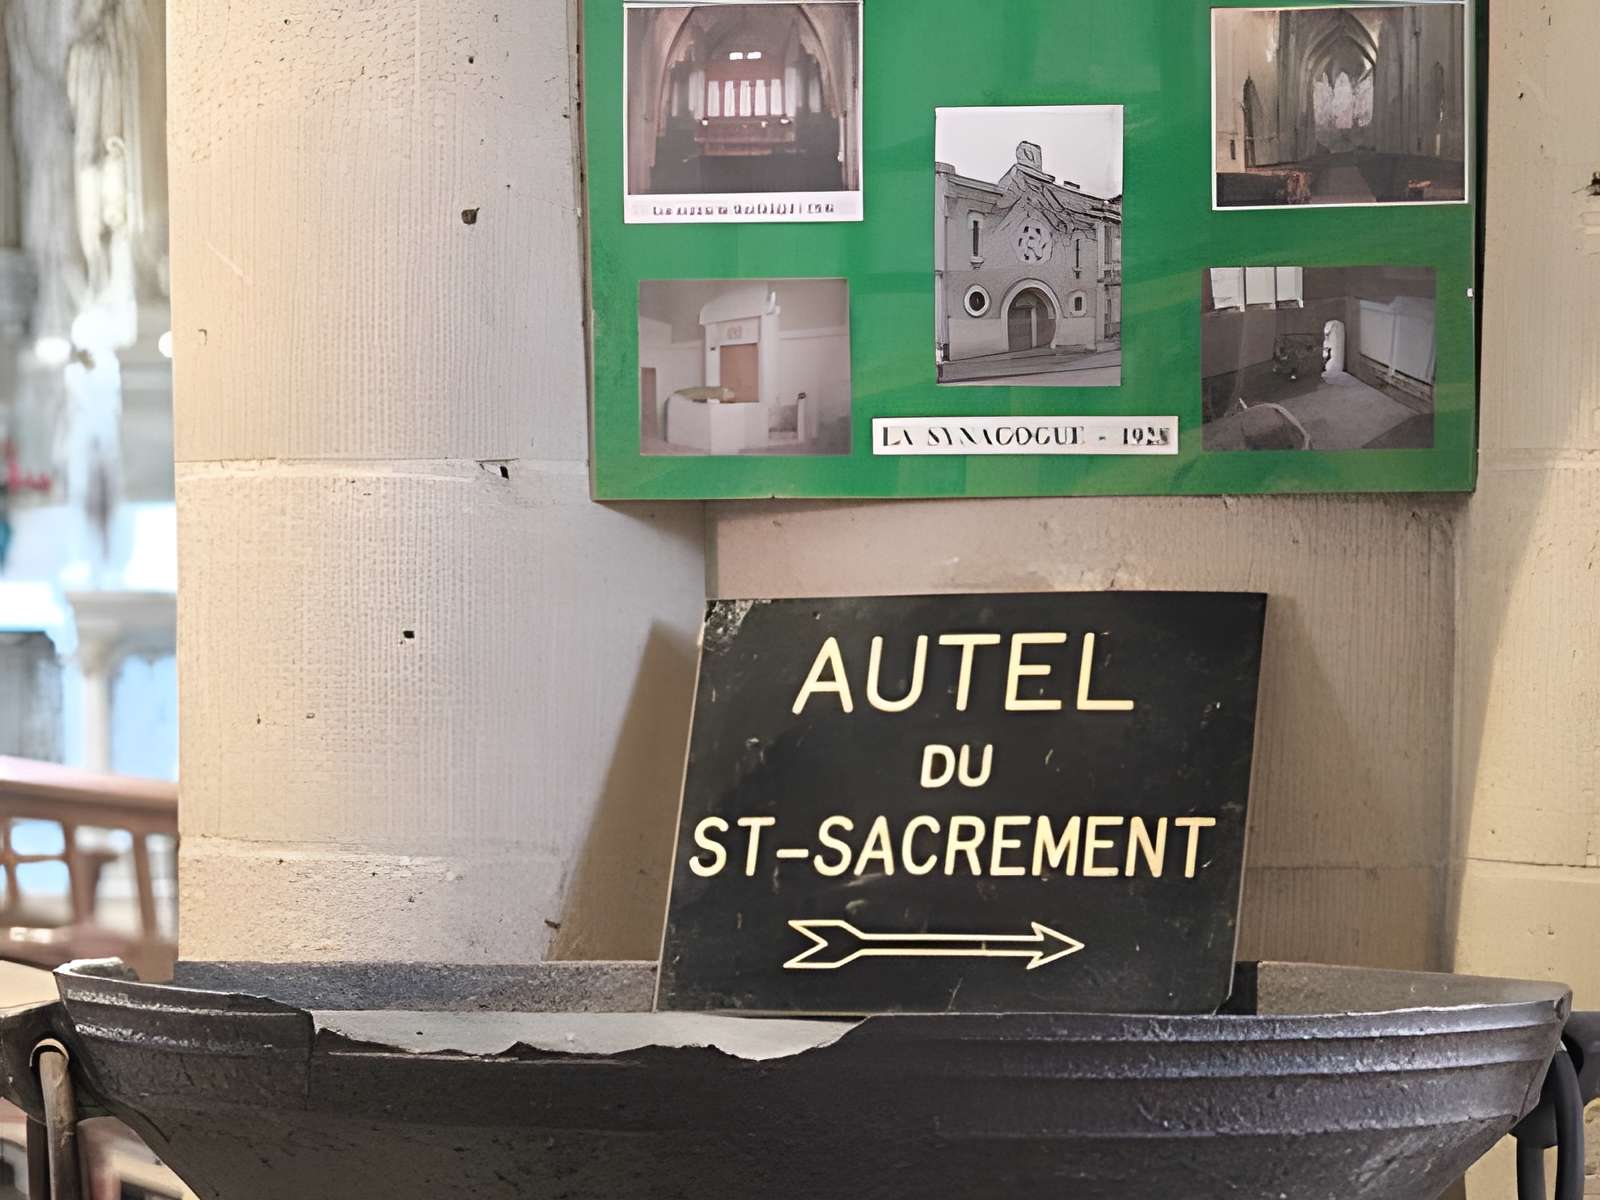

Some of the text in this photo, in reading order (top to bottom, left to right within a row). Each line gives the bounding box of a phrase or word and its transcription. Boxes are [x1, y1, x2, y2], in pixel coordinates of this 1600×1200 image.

[883, 426, 913, 446] LA
[792, 632, 1134, 714] AUTEL
[920, 744, 993, 788] DU
[689, 815, 1216, 878] ST-SACREMENT
